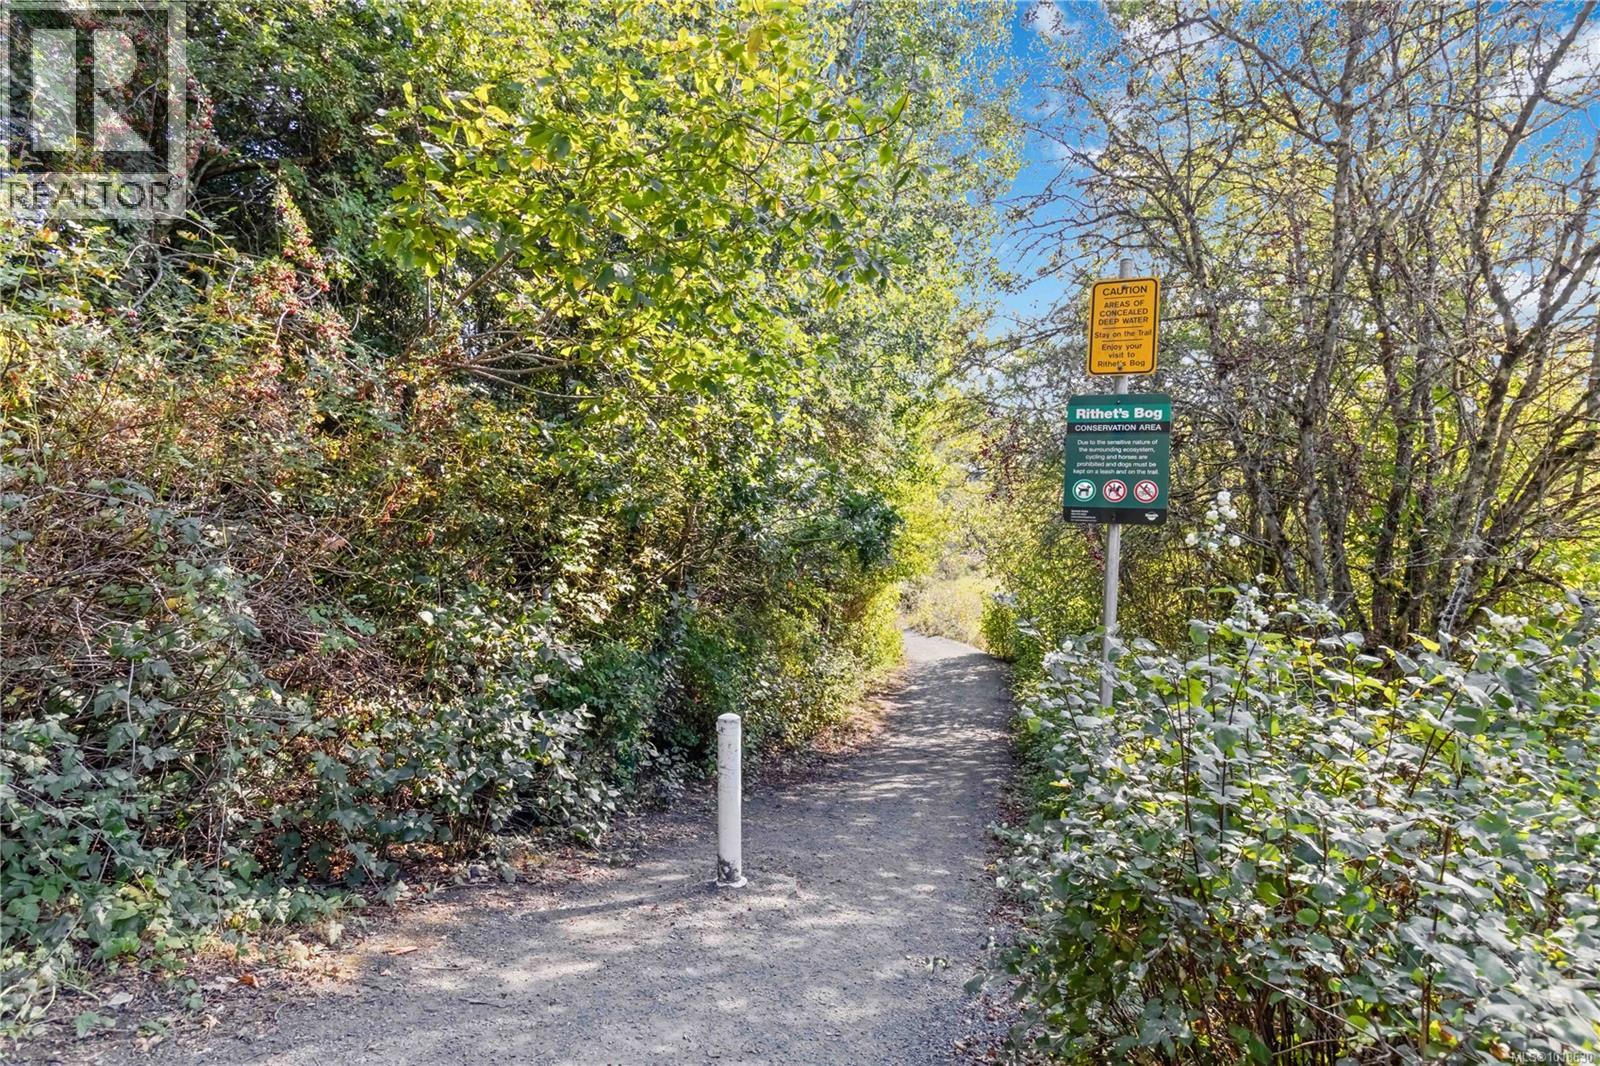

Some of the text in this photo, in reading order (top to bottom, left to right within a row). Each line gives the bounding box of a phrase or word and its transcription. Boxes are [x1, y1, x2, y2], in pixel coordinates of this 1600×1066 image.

[1102, 285, 1147, 296] CAUTION
[1104, 299, 1145, 309] AREAS OF
[1099, 308, 1149, 318] CONCEALED
[1098, 318, 1120, 326] DEEP
[1094, 331, 1112, 339] Stay
[1101, 344, 1122, 352] Enjoy
[1129, 359, 1146, 368] Bog
[1076, 407, 1163, 421] Rithet's Bog
[1075, 423, 1162, 432] CONSERVATION AREA
